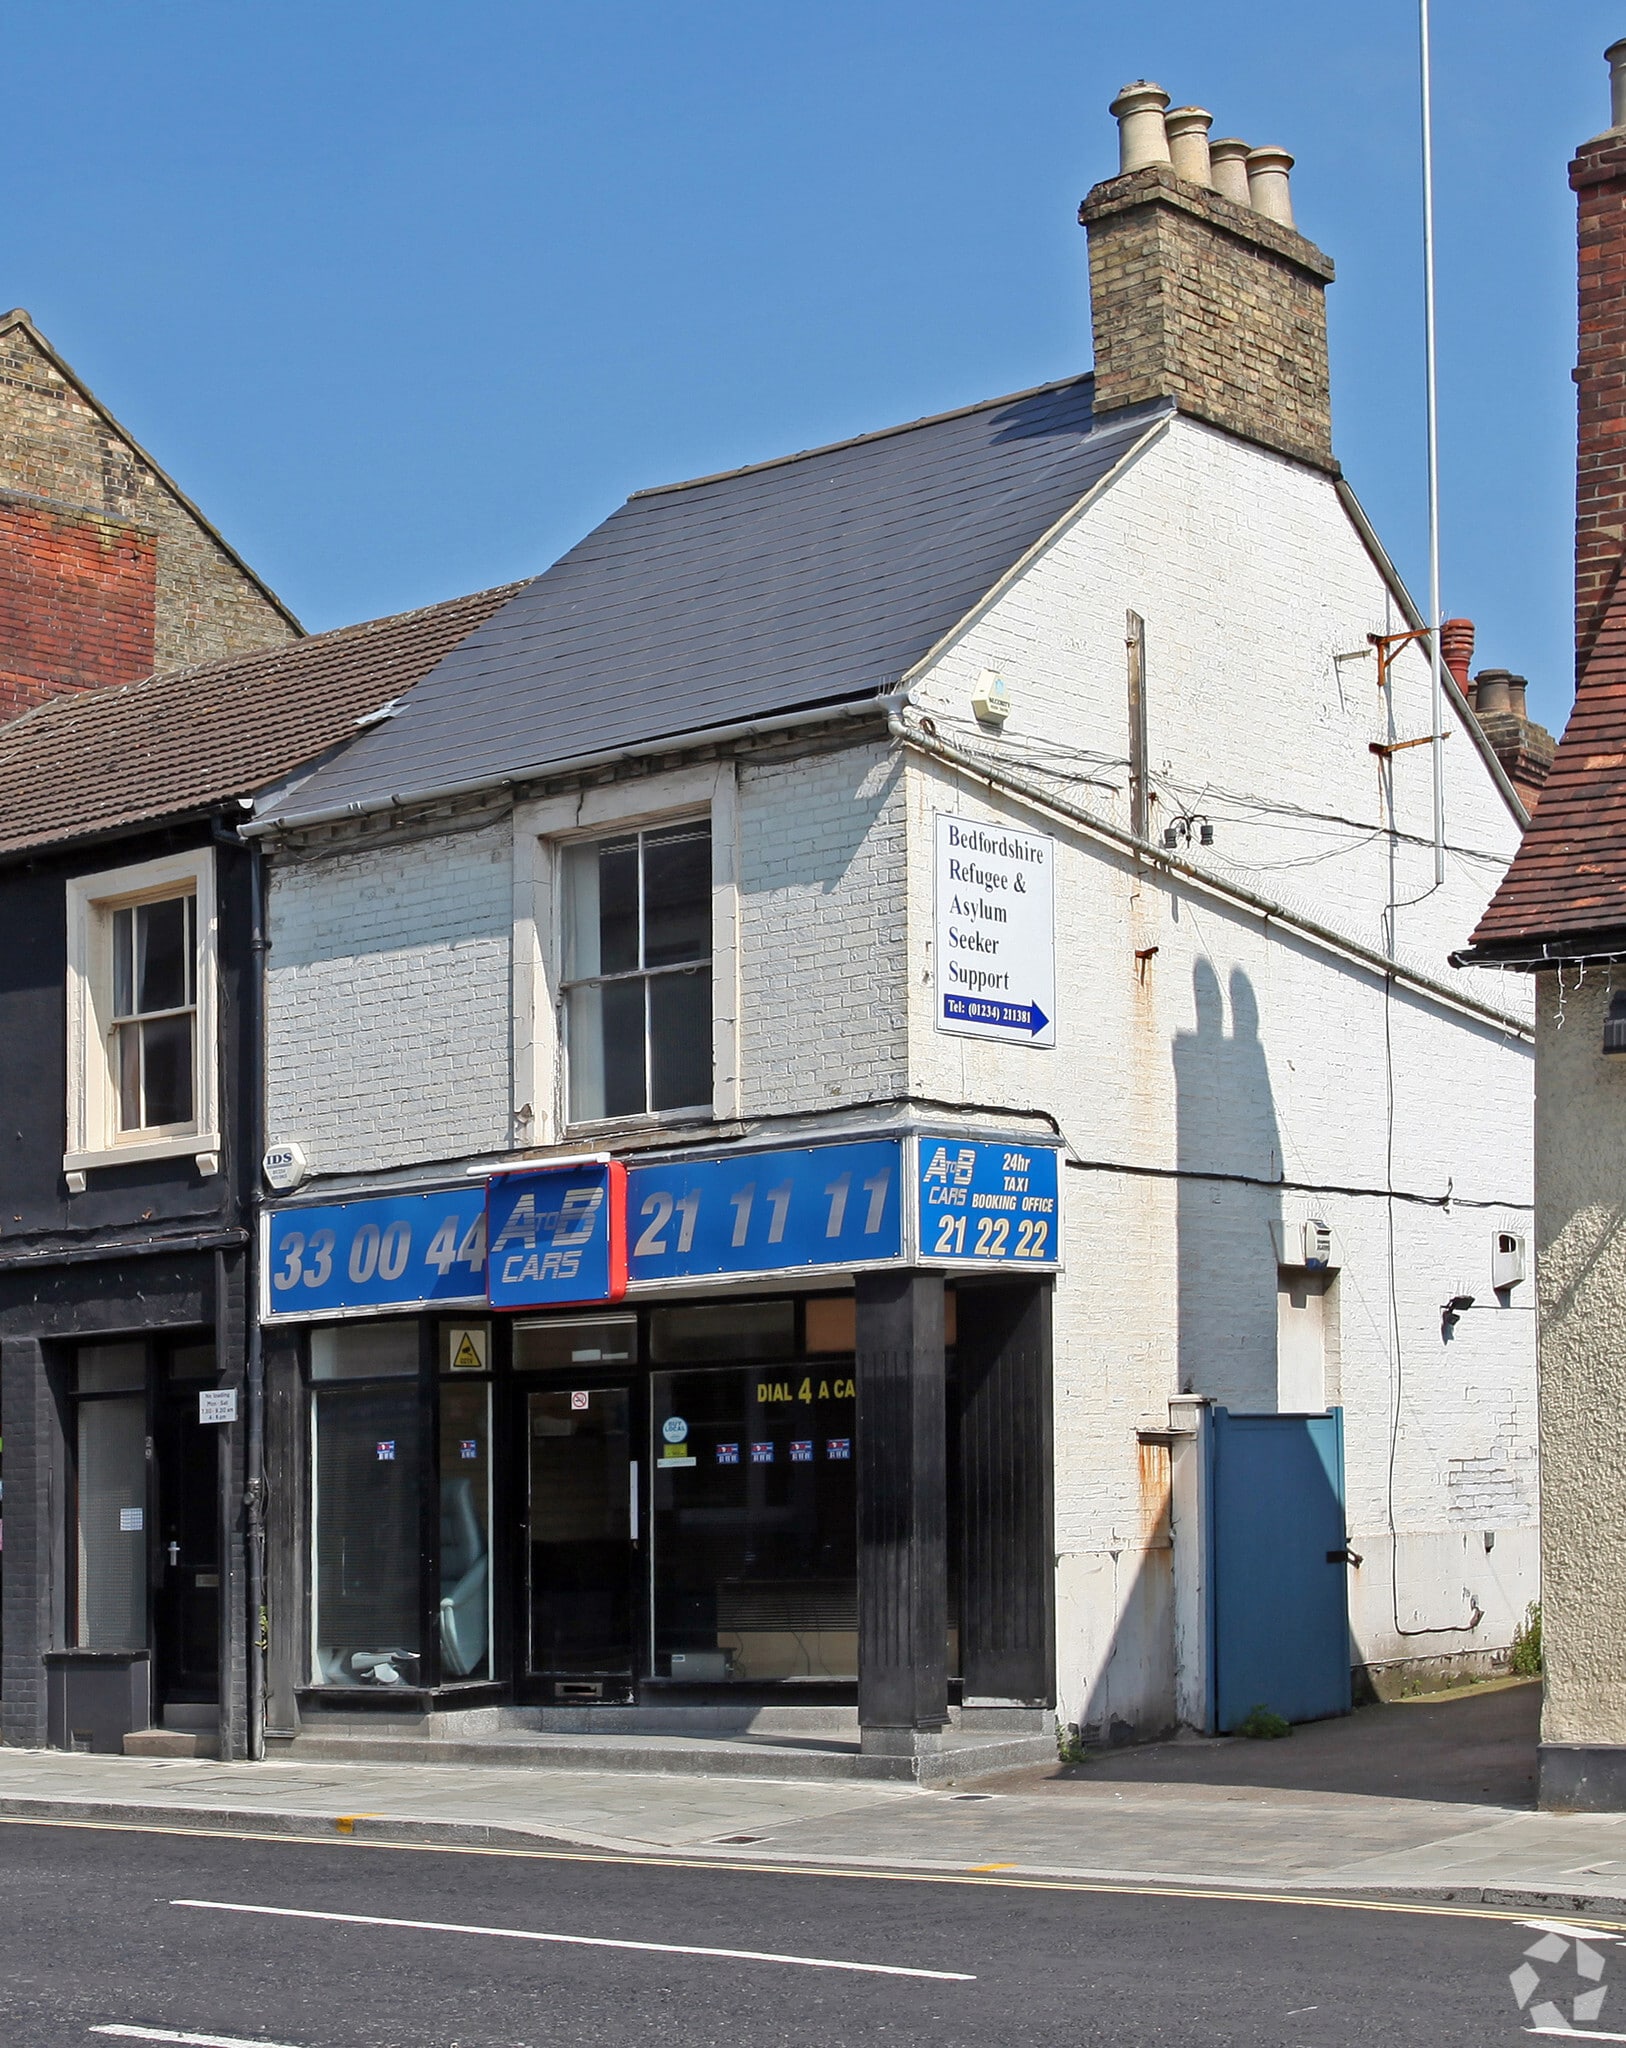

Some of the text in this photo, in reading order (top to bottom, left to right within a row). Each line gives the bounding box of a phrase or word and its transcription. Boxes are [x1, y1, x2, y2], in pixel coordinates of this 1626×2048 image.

[949, 824, 1043, 864] Bedfordshire
[949, 858, 1026, 893] Refugee &
[949, 894, 1007, 923] Asylum
[949, 926, 999, 954] Seeker
[949, 960, 1009, 992] Support
[948, 999, 1031, 1023] Tel: (01234) 211381
[267, 1152, 292, 1165] IDS
[1002, 1153, 1031, 1172] 24hr
[928, 1186, 968, 1206] CARS
[1003, 1176, 1029, 1192] TAXI
[634, 1167, 891, 1257] 21 11 11
[972, 1193, 1054, 1213] BOOKING OFFICE
[934, 1214, 1048, 1257] 21 22 22
[273, 1213, 487, 1291] 33 00 44
[502, 1250, 583, 1283] CARS
[757, 1383, 793, 1402] DIAL
[798, 1377, 812, 1404] 4
[818, 1380, 830, 1399] A
[664, 1425, 685, 1433] LOCAL
